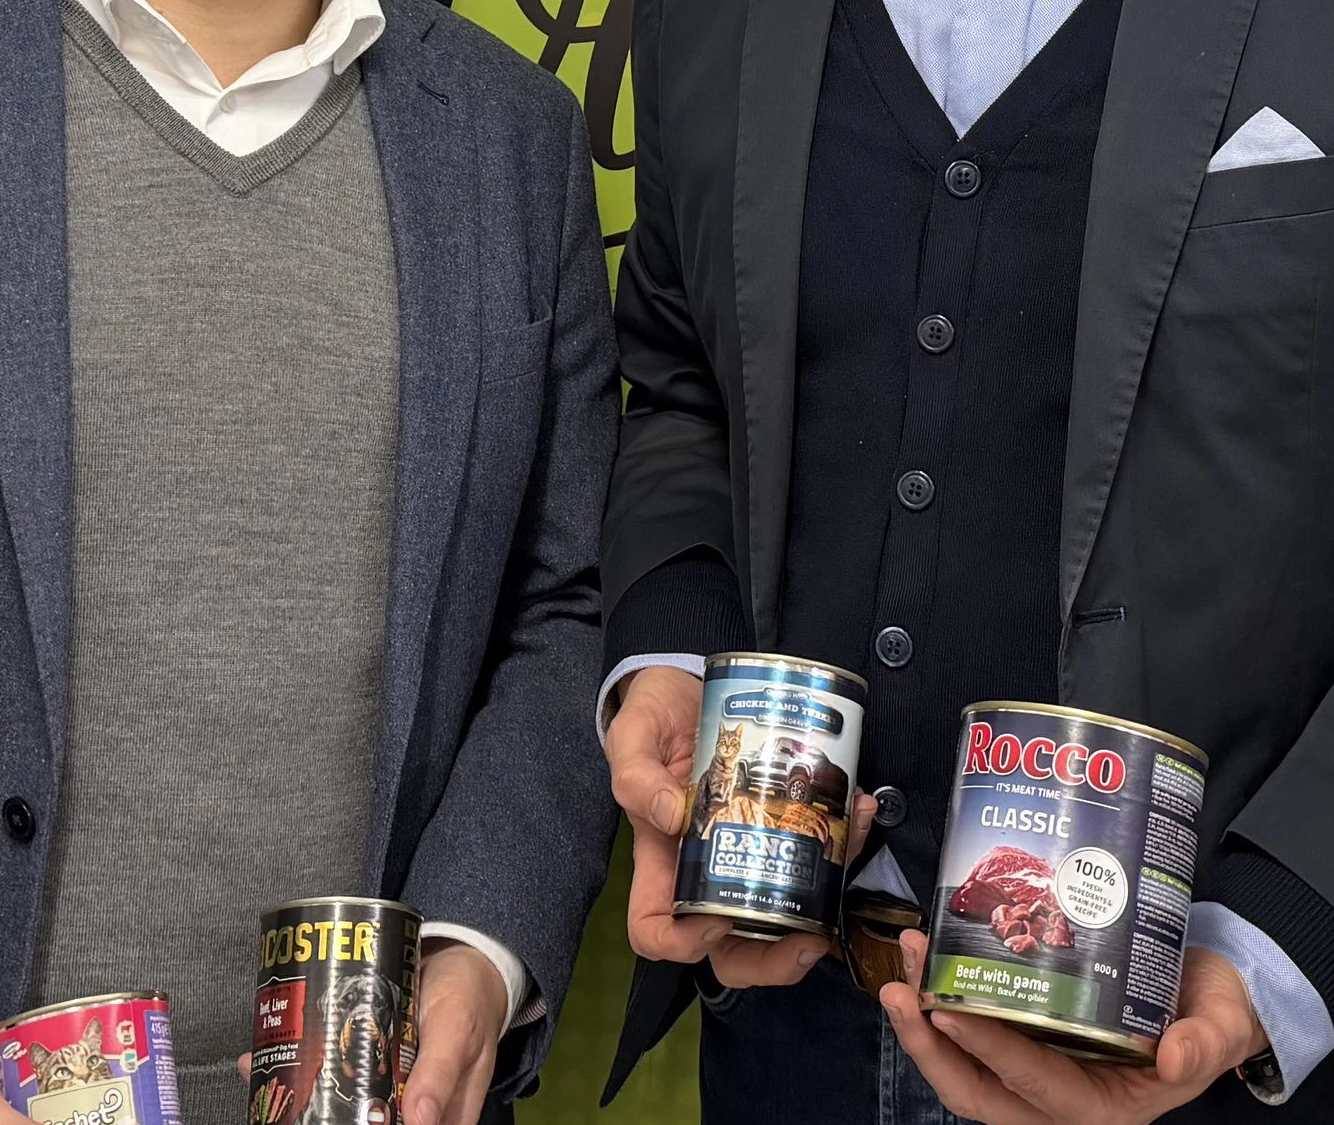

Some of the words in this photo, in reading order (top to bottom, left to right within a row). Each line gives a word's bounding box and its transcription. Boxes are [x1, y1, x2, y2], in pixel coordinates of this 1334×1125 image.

[730, 700, 773, 709] CHICKEN
[778, 703, 799, 713] AND
[1011, 784, 1035, 796] MEAT
[1038, 788, 1061, 800] TIME
[981, 805, 1072, 838] CLASSIC
[718, 831, 812, 864] RANCH
[716, 852, 813, 879] COLLECTION
[1075, 858, 1117, 886] 100%
[1082, 881, 1103, 893] FRESH
[732, 892, 757, 901] WEIGHT
[759, 896, 773, 904] 14.6
[796, 904, 801, 912] g
[1069, 895, 1107, 914] GRAIN-FREE
[1075, 905, 1097, 919] RECIPE
[956, 964, 981, 980] Beef
[983, 968, 1010, 986] with
[1013, 975, 1050, 993] game
[1094, 962, 1111, 975] 800
[1112, 969, 1118, 979] g
[953, 980, 966, 989] Rind
[966, 983, 977, 991] mit
[978, 984, 993, 994] Wild
[1027, 993, 1049, 1004] gibier
[272, 998, 288, 1011] Liver
[267, 1015, 282, 1028] Peas
[270, 1051, 297, 1063] STAGES
